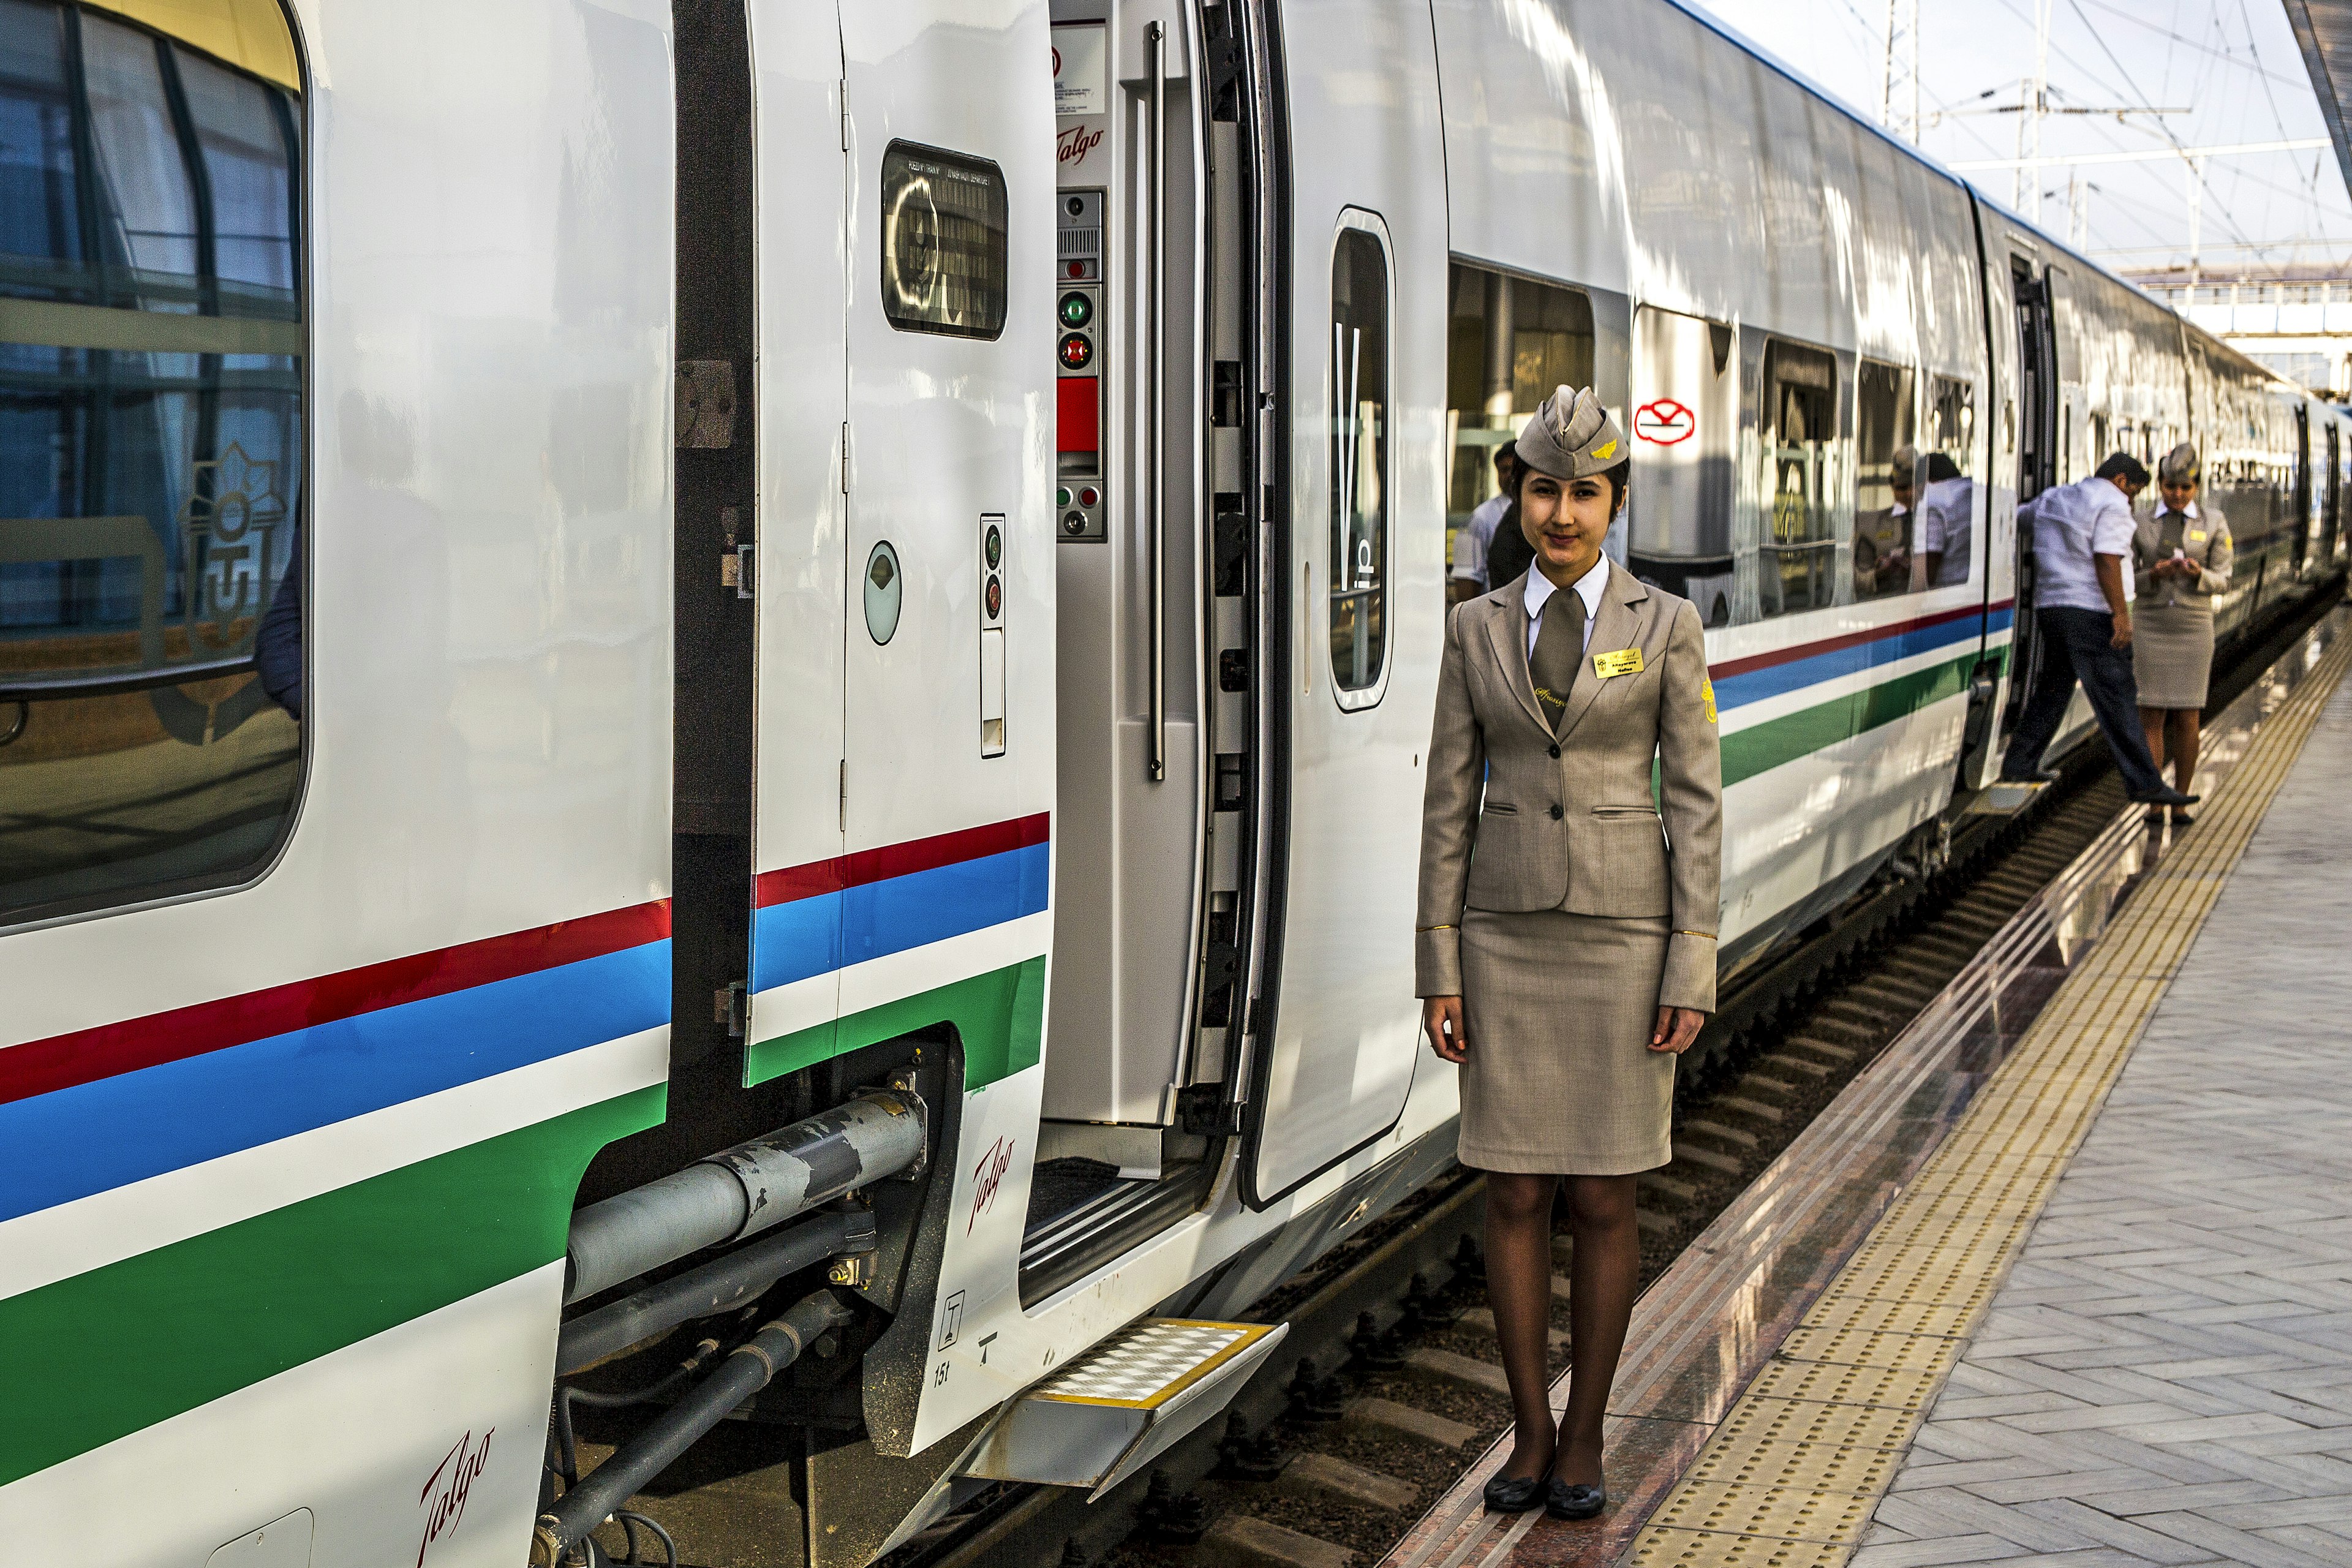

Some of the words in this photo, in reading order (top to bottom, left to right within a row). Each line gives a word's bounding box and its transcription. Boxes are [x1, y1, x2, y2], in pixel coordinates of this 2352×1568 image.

[1057, 124, 1104, 166] Talgo
[967, 1135, 1016, 1238] Talgo
[934, 1360, 950, 1389] 15t
[417, 1426, 496, 1568] Talgo
